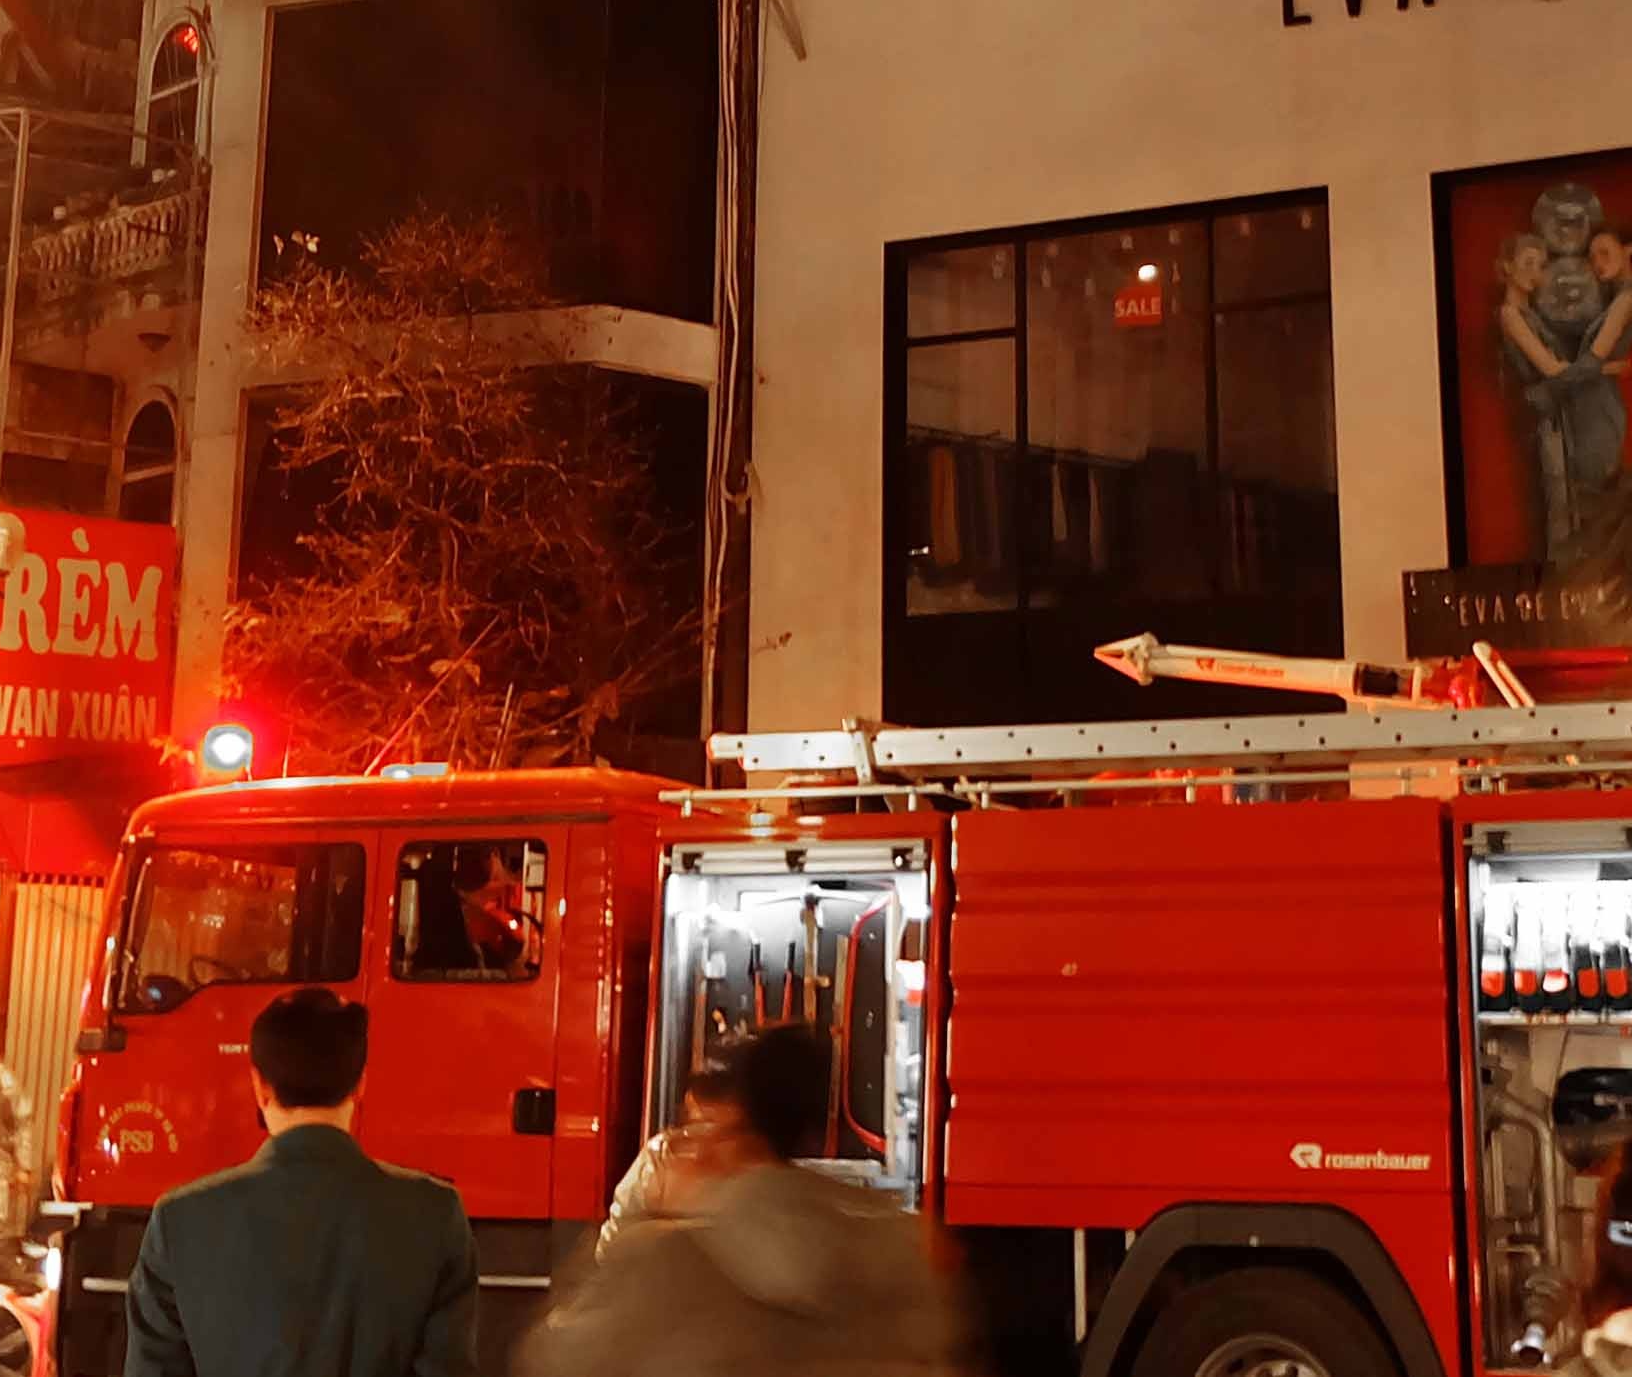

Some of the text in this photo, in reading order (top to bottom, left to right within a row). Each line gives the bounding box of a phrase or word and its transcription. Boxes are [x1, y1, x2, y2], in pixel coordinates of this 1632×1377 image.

[1114, 297, 1161, 318] SALE
[69, 683, 157, 743] XUÂN
[1325, 1148, 1431, 1171] rosenbauer
